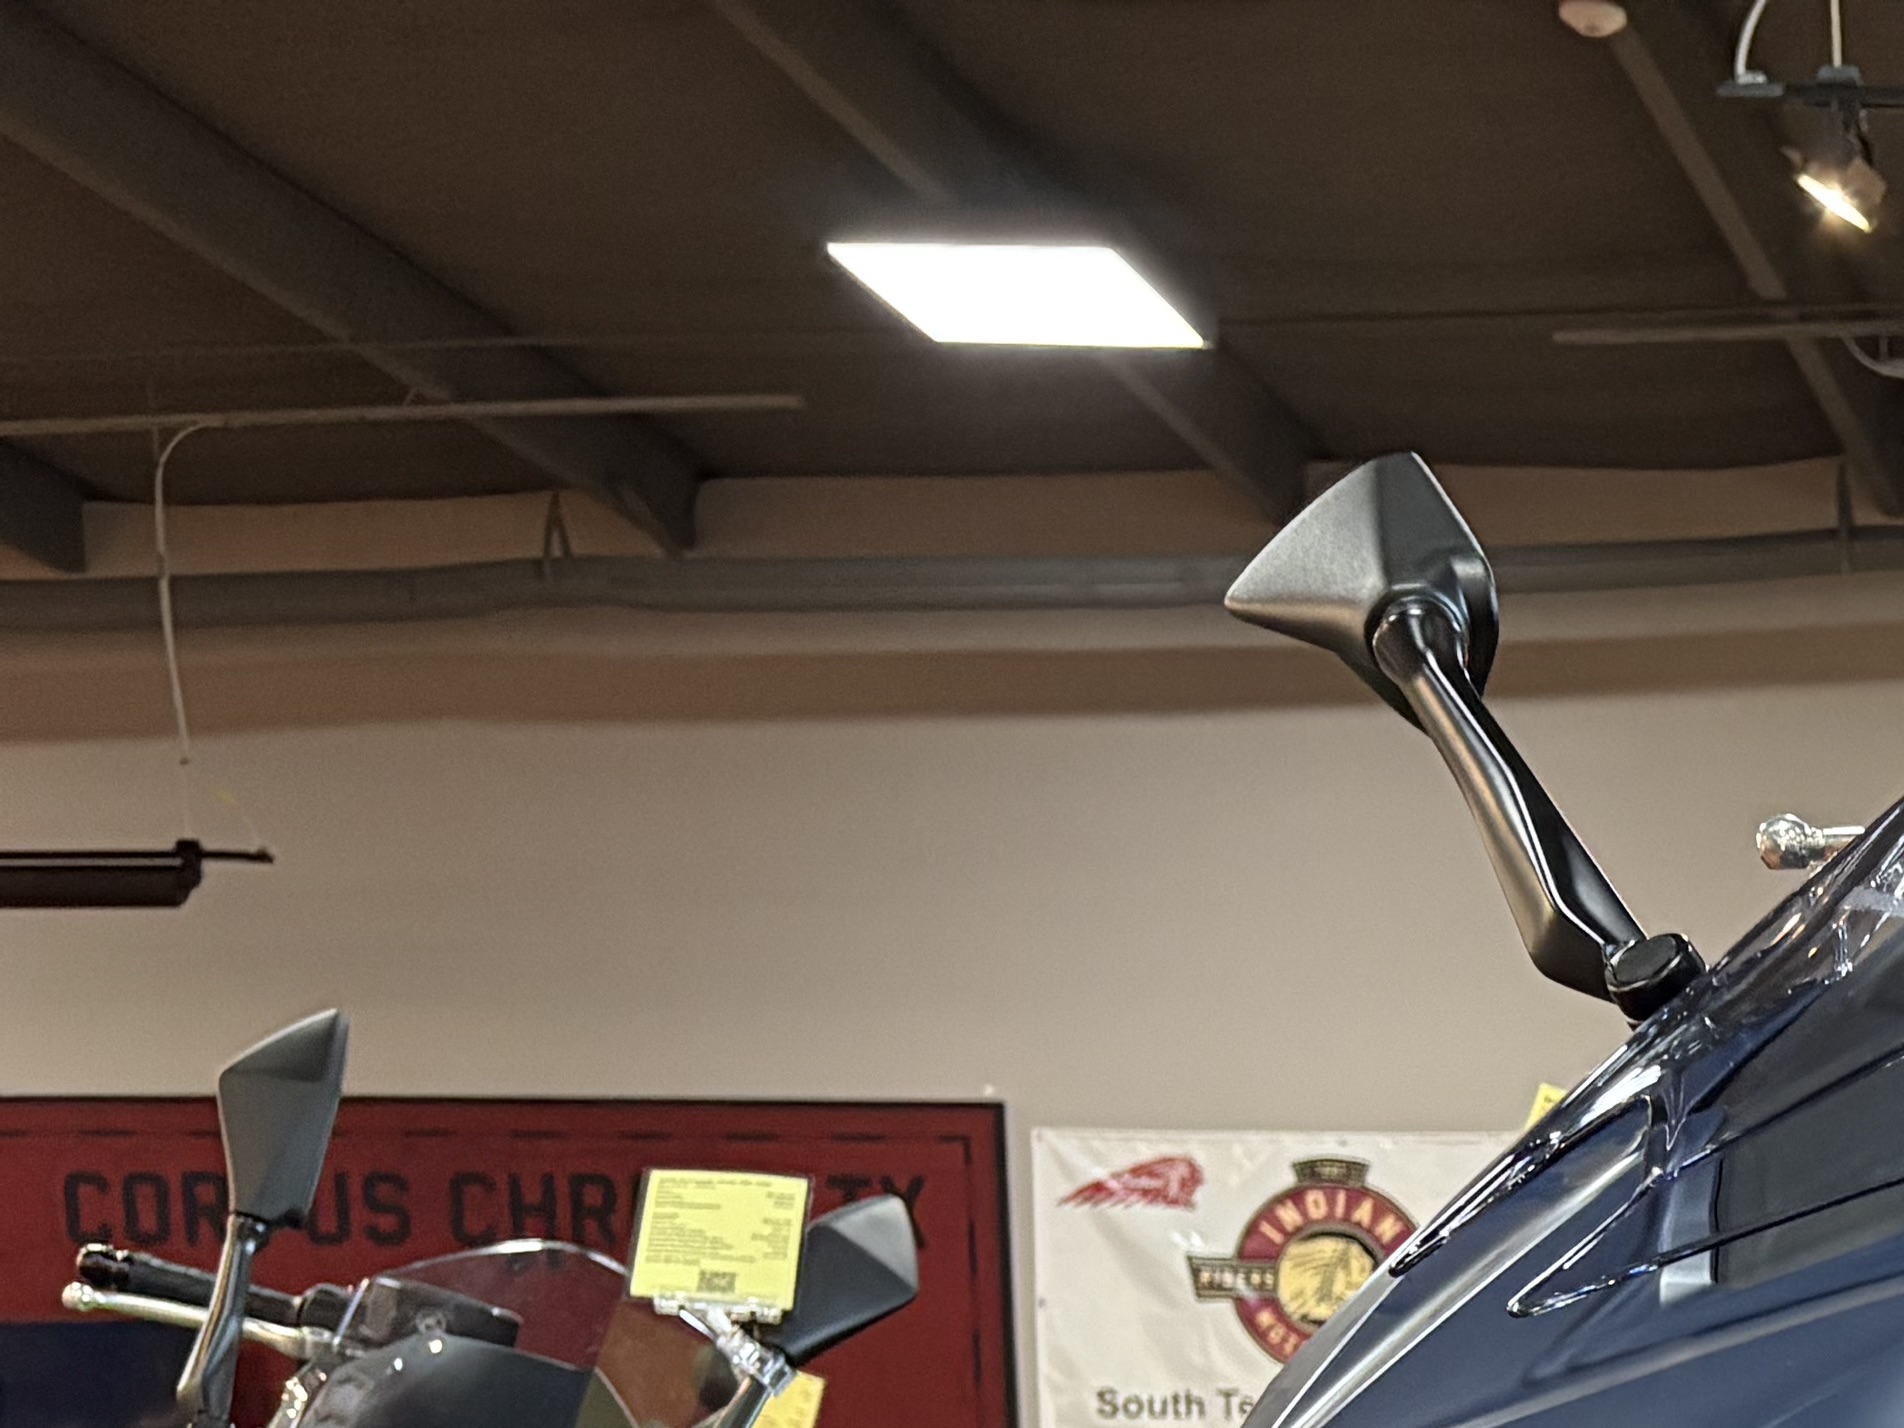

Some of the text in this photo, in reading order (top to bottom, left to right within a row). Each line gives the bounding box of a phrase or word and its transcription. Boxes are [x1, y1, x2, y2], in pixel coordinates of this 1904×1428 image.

[63, 1171, 411, 1247] CORUS
[1258, 1188, 1404, 1245] INDIAN
[1095, 1385, 1206, 1420] South
